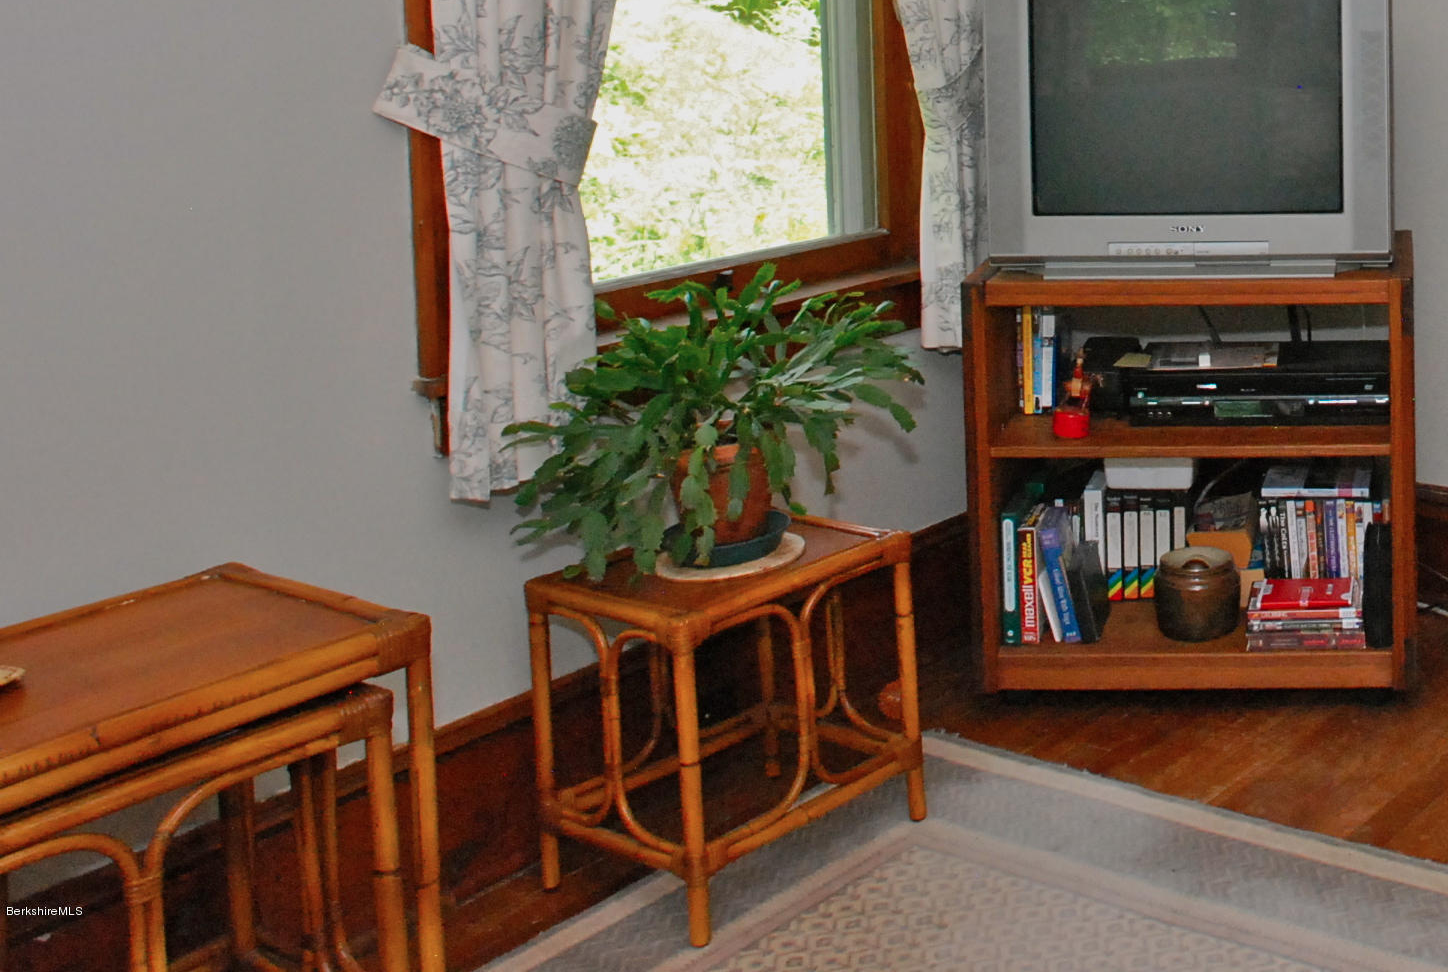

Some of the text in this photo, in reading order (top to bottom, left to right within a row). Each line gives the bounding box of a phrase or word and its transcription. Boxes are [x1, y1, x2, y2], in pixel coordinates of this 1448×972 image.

[1281, 528, 1290, 550] Celts
[1022, 559, 1036, 628] maxell VCR
